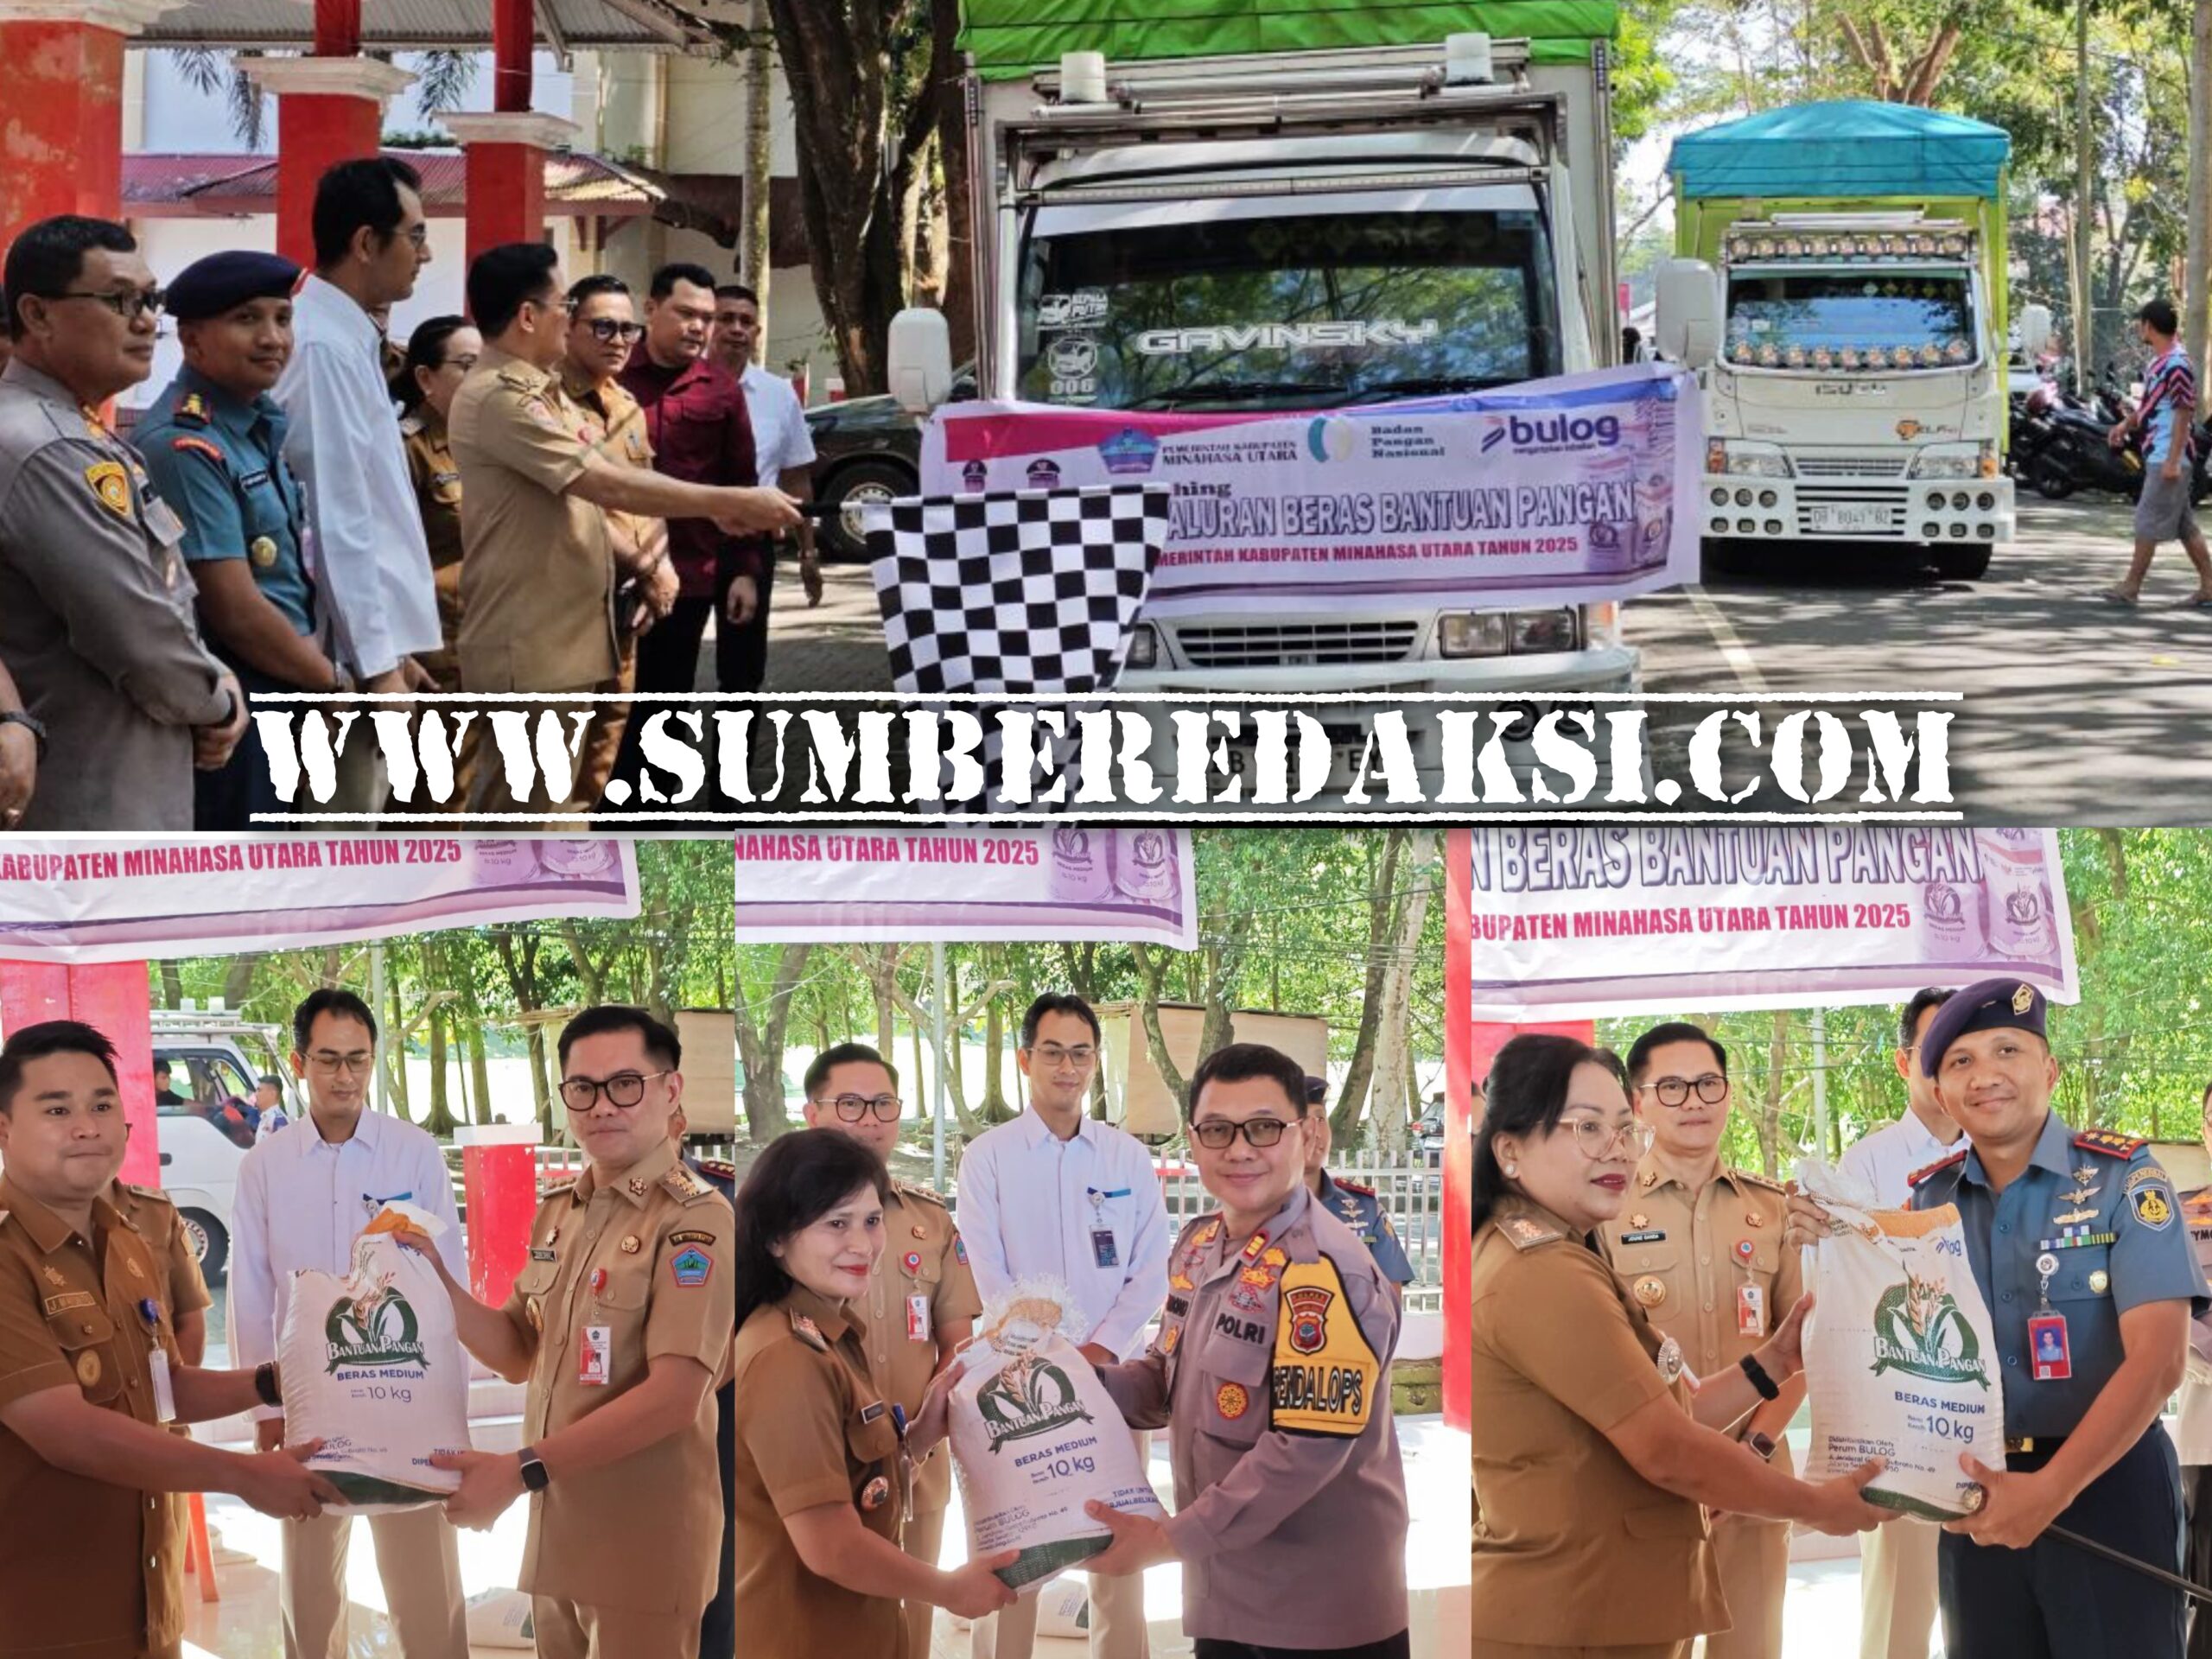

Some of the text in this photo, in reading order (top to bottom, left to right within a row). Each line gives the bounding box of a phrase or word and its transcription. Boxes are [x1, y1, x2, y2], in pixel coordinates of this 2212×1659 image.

[1137, 320, 1437, 354] GAVINSKY
[1371, 425, 1423, 434] Badan
[1371, 437, 1433, 446] Pangan
[1509, 414, 1619, 447] bulog
[1163, 448, 1297, 466] MINAHASA UTARA
[1371, 447, 1445, 459] Nasional
[1281, 493, 1374, 536] BERAS
[1380, 487, 1510, 533] BANTUAN
[1517, 480, 1635, 528] PANGAN
[1239, 546, 1328, 562] KABUPATEN
[1332, 543, 1418, 562] MINAHASA
[1421, 539, 1473, 558] UTARA
[1478, 538, 1531, 556] TAHUN
[1535, 537, 1578, 553] 2025
[123, 844, 244, 877] MINAHASA
[248, 841, 322, 870] UTARA
[325, 840, 399, 867] TAHUN
[404, 840, 461, 864] 2025
[827, 836, 900, 862] UTARA
[904, 837, 978, 864] TAHUN
[982, 839, 1039, 865] 2025
[1500, 828, 1631, 893] BERAS
[1640, 828, 1819, 887] BANTUAN
[1825, 828, 1981, 884] PANGAN
[1573, 906, 1693, 932] MINAHASA
[1698, 906, 1771, 931] UTARA
[1775, 904, 1848, 930] TAHUN
[1853, 903, 1911, 928] 2025
[1215, 1313, 1266, 1344] POLRI
[337, 1370, 424, 1381] BERAS MEDIUM
[367, 1386, 412, 1402] 10 kg
[1895, 1391, 1985, 1414] BERAS MEDIUM
[1926, 1415, 1974, 1444] 10 kg
[1014, 1436, 1097, 1467] BERAS MEDIUM
[1828, 1443, 1896, 1457] Perum BULOG
[1072, 1455, 1096, 1473] kg
